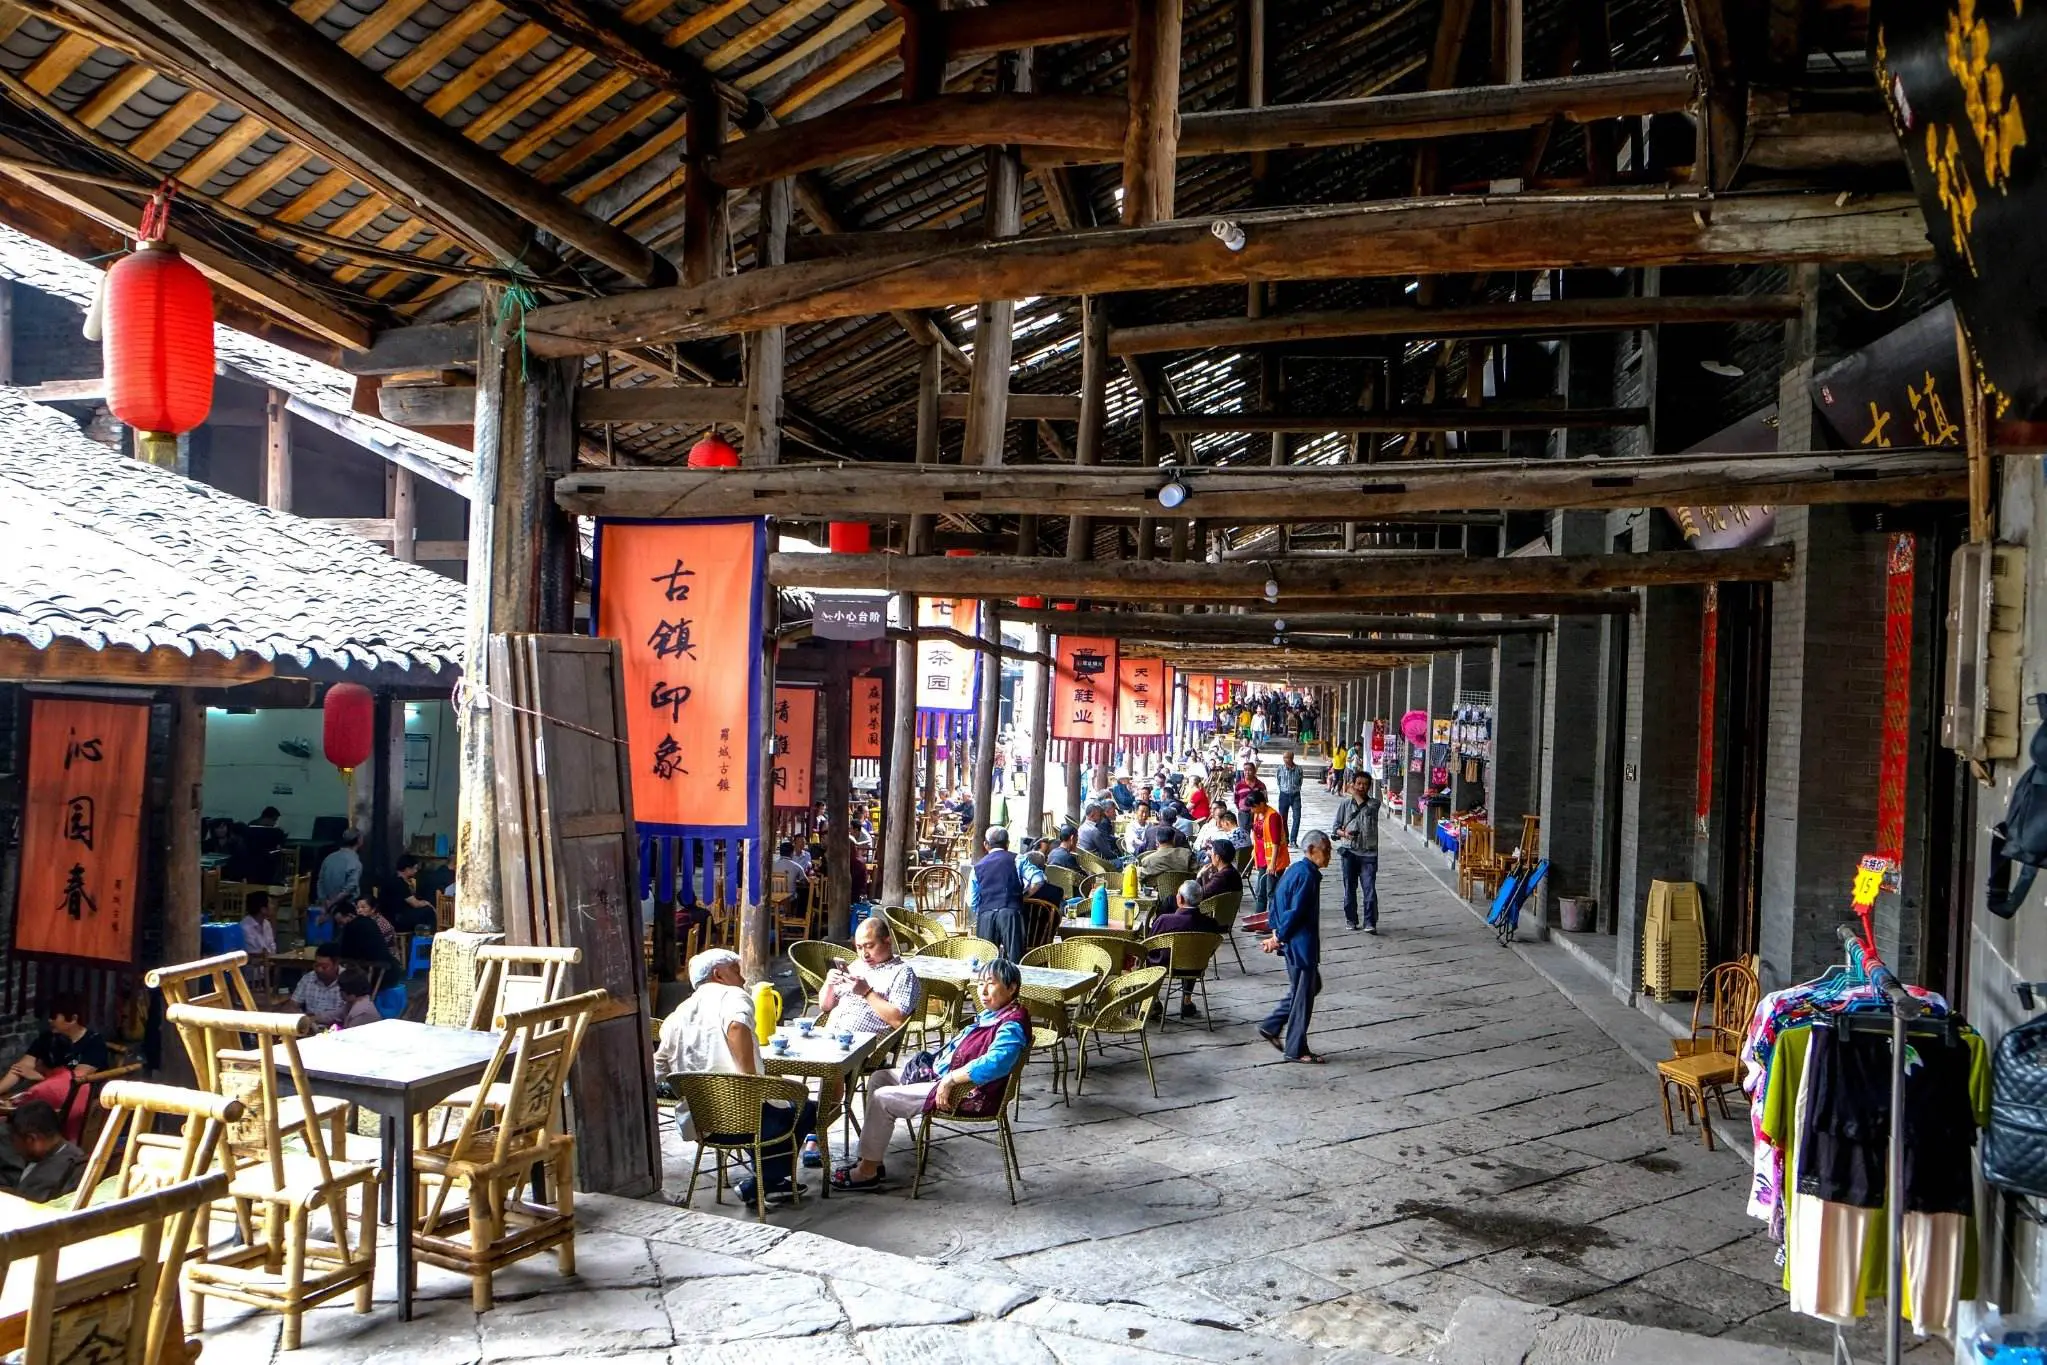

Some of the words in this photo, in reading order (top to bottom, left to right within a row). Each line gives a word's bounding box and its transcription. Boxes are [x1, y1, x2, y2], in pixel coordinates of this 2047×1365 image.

[834, 610, 881, 623] 小心台阶
[1134, 668, 1149, 724] 天宝百货
[1859, 876, 1873, 894] 15
